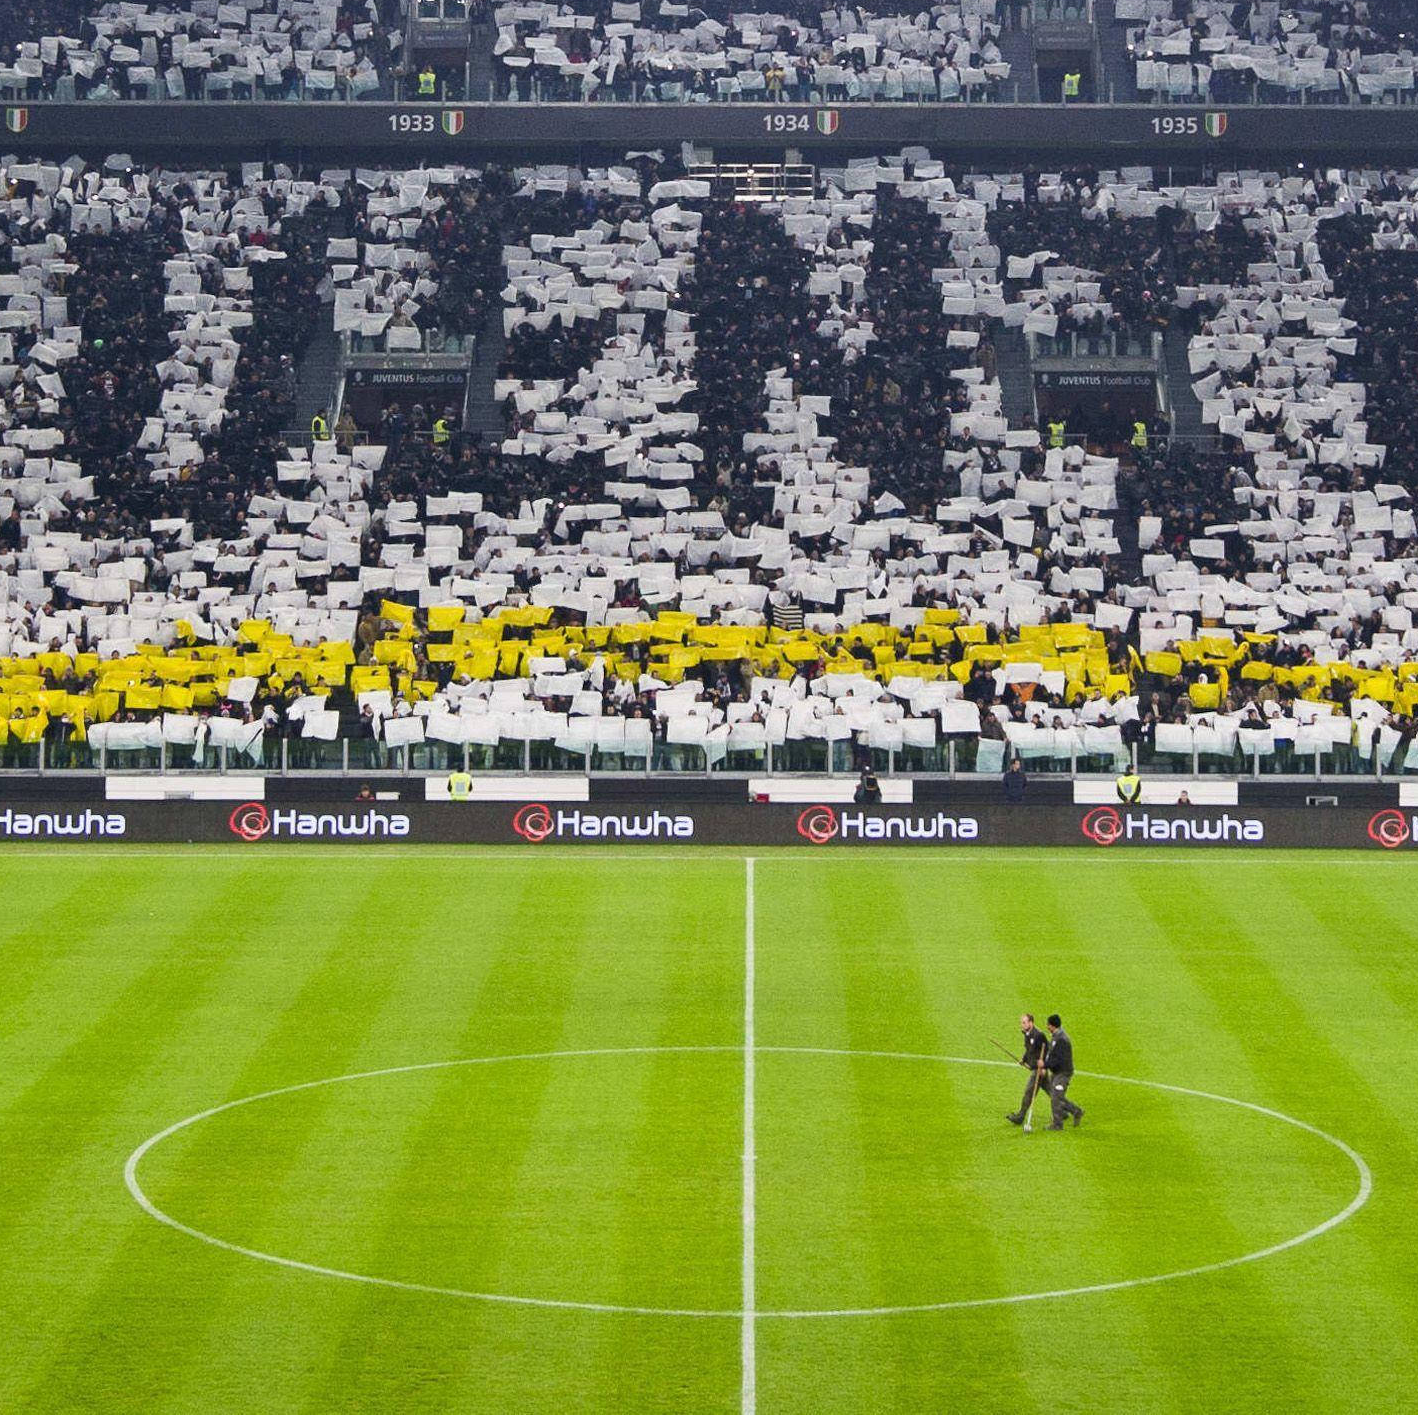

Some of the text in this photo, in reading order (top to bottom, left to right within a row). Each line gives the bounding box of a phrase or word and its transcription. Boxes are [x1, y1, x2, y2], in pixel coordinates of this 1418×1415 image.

[388, 114, 435, 132] 1933
[763, 114, 810, 132] 1934
[1151, 117, 1198, 134] 1935
[373, 374, 463, 383] JUVENTUS Football Club
[1058, 376, 1151, 385] JUVENTUS Football Club
[272, 810, 409, 834] Hanwha
[555, 811, 693, 836] Hanwha
[840, 813, 978, 837] Hanwha
[1125, 814, 1263, 839] Hanwha
